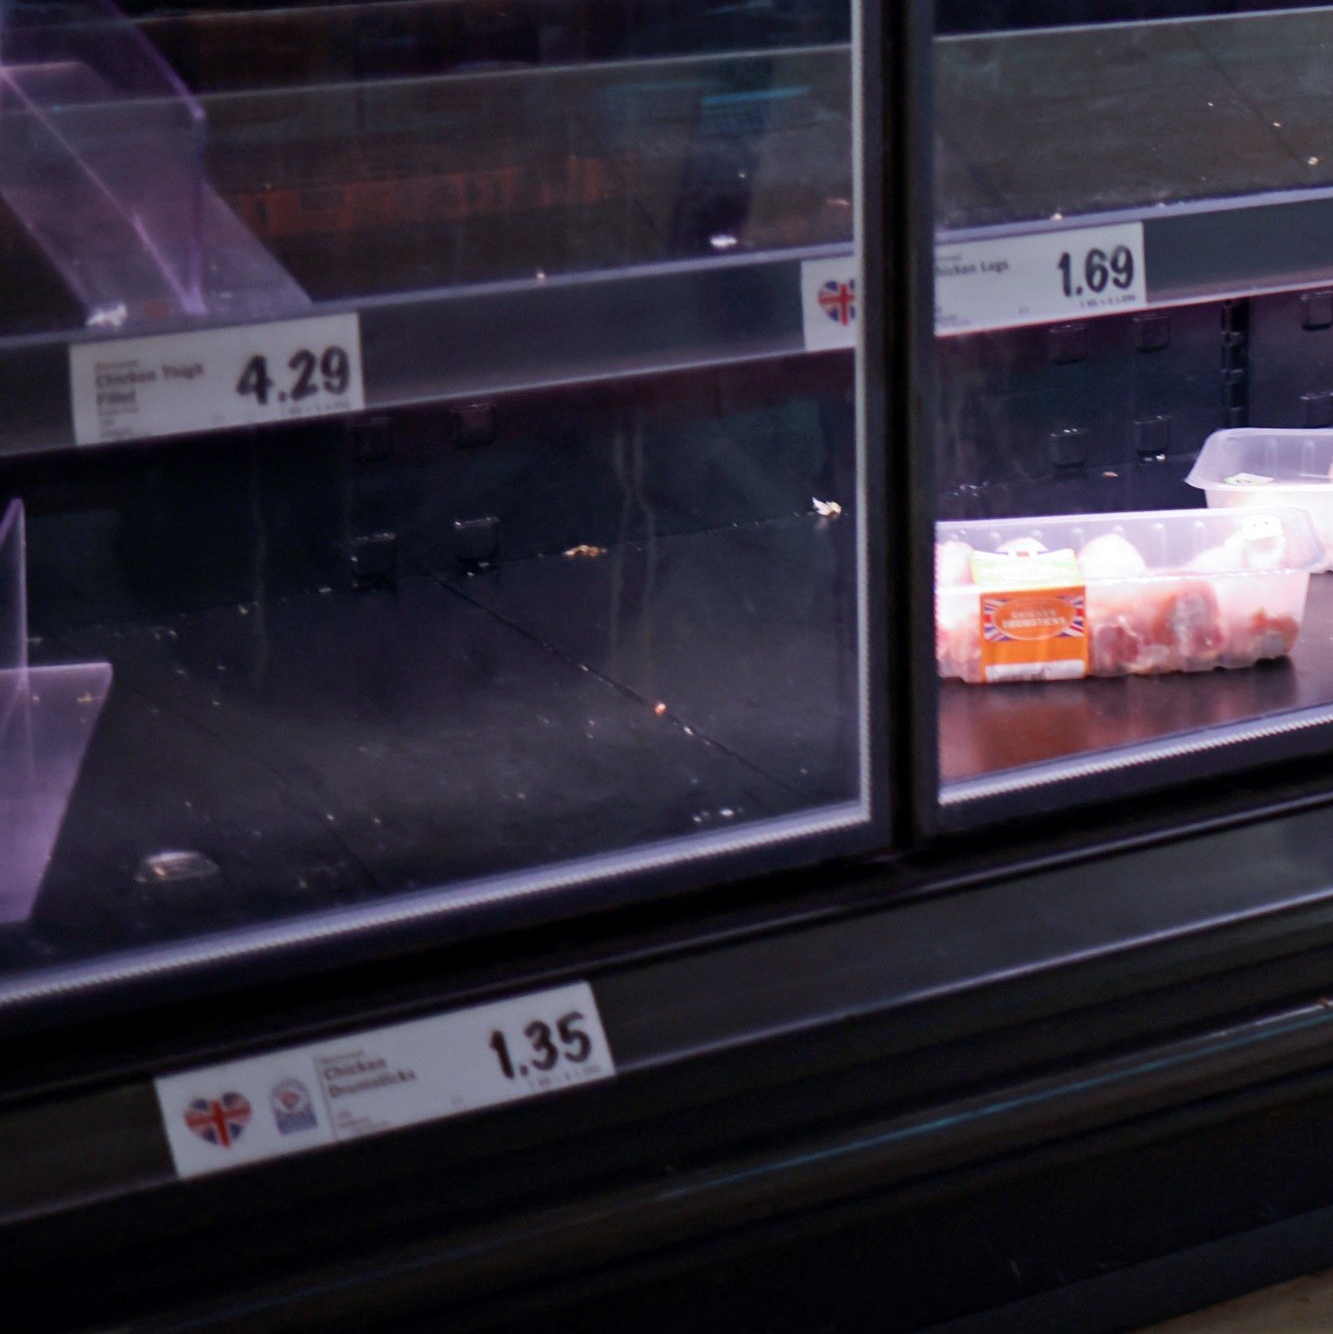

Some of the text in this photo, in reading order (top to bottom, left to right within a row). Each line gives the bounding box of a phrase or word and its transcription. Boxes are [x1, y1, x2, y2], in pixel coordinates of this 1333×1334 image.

[980, 259, 1009, 275] Legs
[1056, 244, 1135, 298] 1.69
[235, 345, 350, 406] 4.29
[487, 1009, 594, 1080] 1.35
[322, 1055, 388, 1081] Chicken
[329, 1067, 417, 1099] Drumsticks
